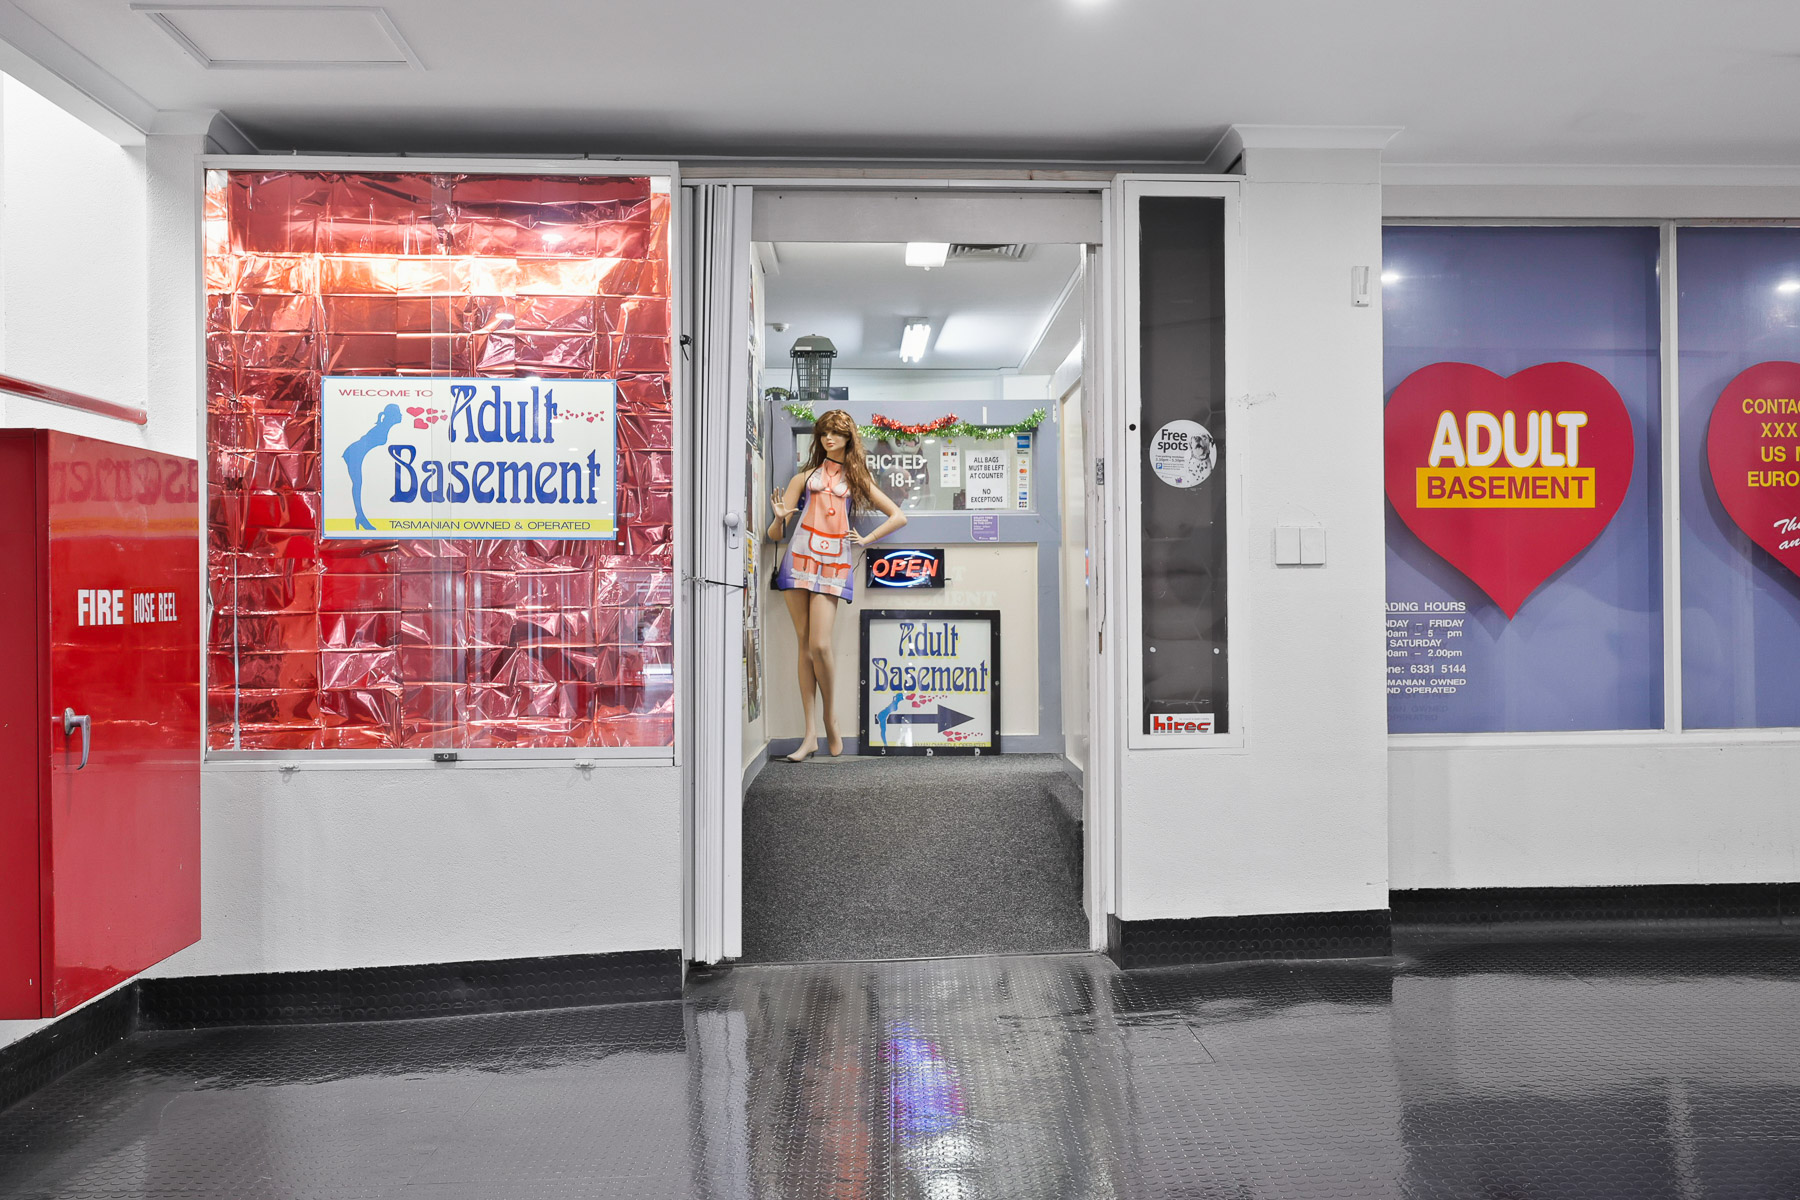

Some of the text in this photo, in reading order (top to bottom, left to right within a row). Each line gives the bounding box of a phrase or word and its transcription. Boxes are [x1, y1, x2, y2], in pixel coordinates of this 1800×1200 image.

[338, 388, 434, 398] WELCOME TO
[448, 385, 558, 443] Adult
[1161, 428, 1188, 441] Free
[1760, 422, 1798, 438] XXX
[1428, 409, 1588, 468] ADULT
[1157, 441, 1189, 453] spots
[1761, 446, 1787, 462] US
[865, 454, 924, 470] RICTED
[387, 444, 601, 504] Basement
[888, 472, 915, 488] 18+
[1747, 470, 1800, 487] EURO
[1427, 476, 1589, 499] BASEMENT
[388, 520, 591, 530] TASMANIAN OWNED & OPERATED
[1773, 516, 1800, 534] Th
[872, 558, 939, 577] OPEN
[77, 589, 178, 626] FIRE HOSE REEL
[1384, 601, 1466, 612] ADING HOURS
[1385, 619, 1409, 628] NDAY
[1429, 619, 1464, 628] FRIDAY
[899, 622, 959, 656] Adult
[1427, 629, 1434, 637] 5
[1447, 630, 1463, 639] pm
[1389, 639, 1443, 647] SATURDAY
[1386, 649, 1408, 657] 0am
[1427, 649, 1463, 658] 2.00pm
[872, 658, 988, 692] Basement
[1385, 664, 1466, 674] ne: 6331 5144
